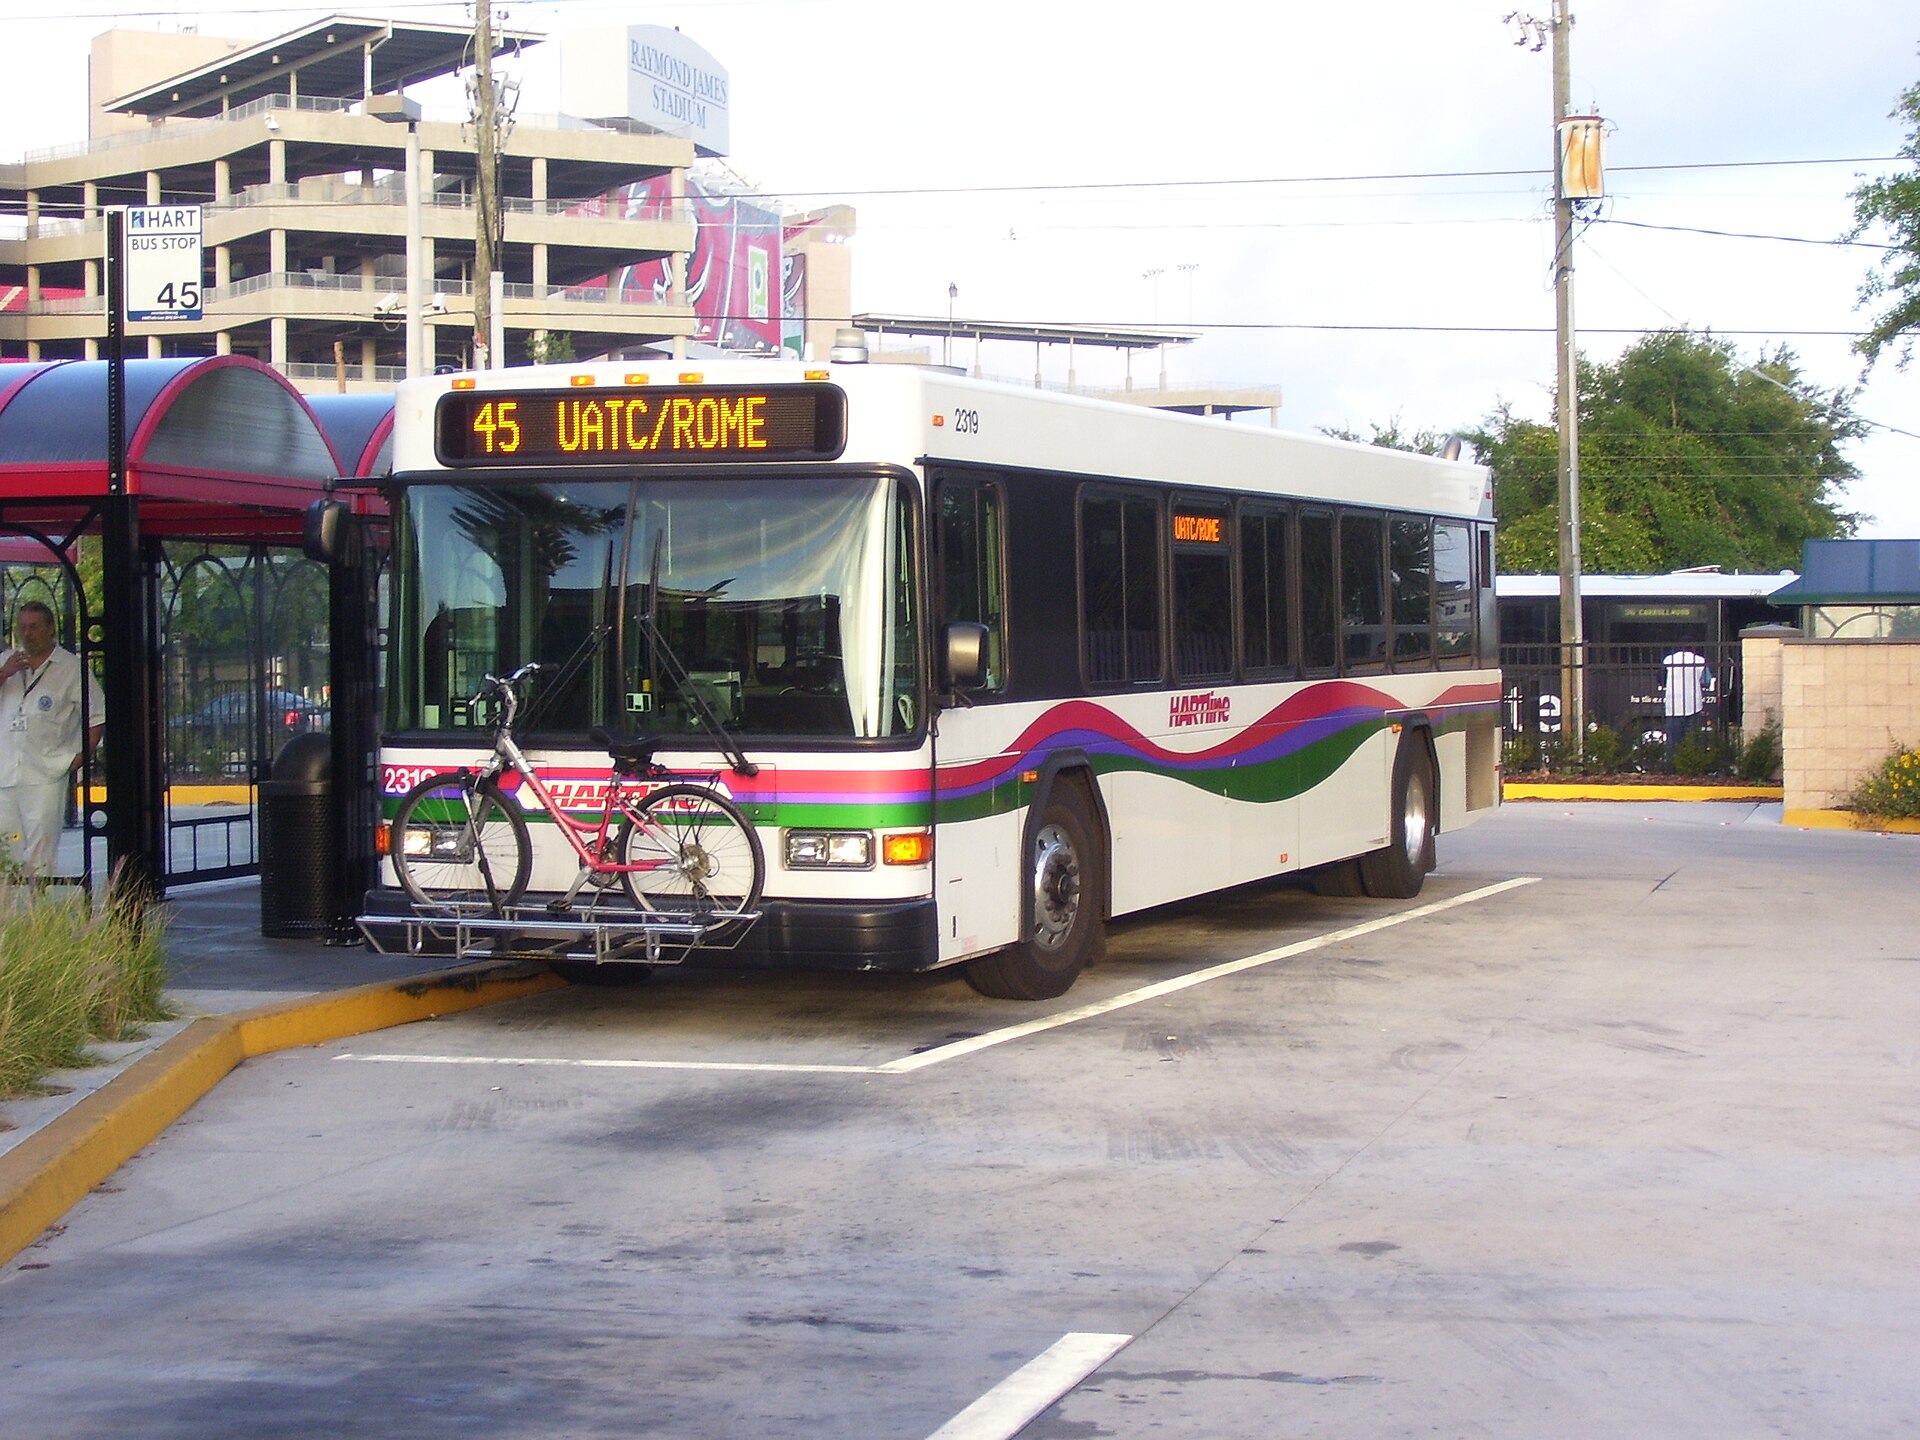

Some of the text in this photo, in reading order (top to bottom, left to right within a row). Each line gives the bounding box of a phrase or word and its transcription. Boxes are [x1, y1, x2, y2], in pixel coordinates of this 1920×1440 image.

[631, 39, 728, 105] RAYMOND JAMES
[653, 84, 707, 129] STADIUM
[148, 209, 197, 228] HART
[131, 237, 197, 251] BUS STOP
[157, 281, 199, 309] 45
[473, 396, 768, 452] 45 UATC/ROME
[954, 407, 979, 434] 2319
